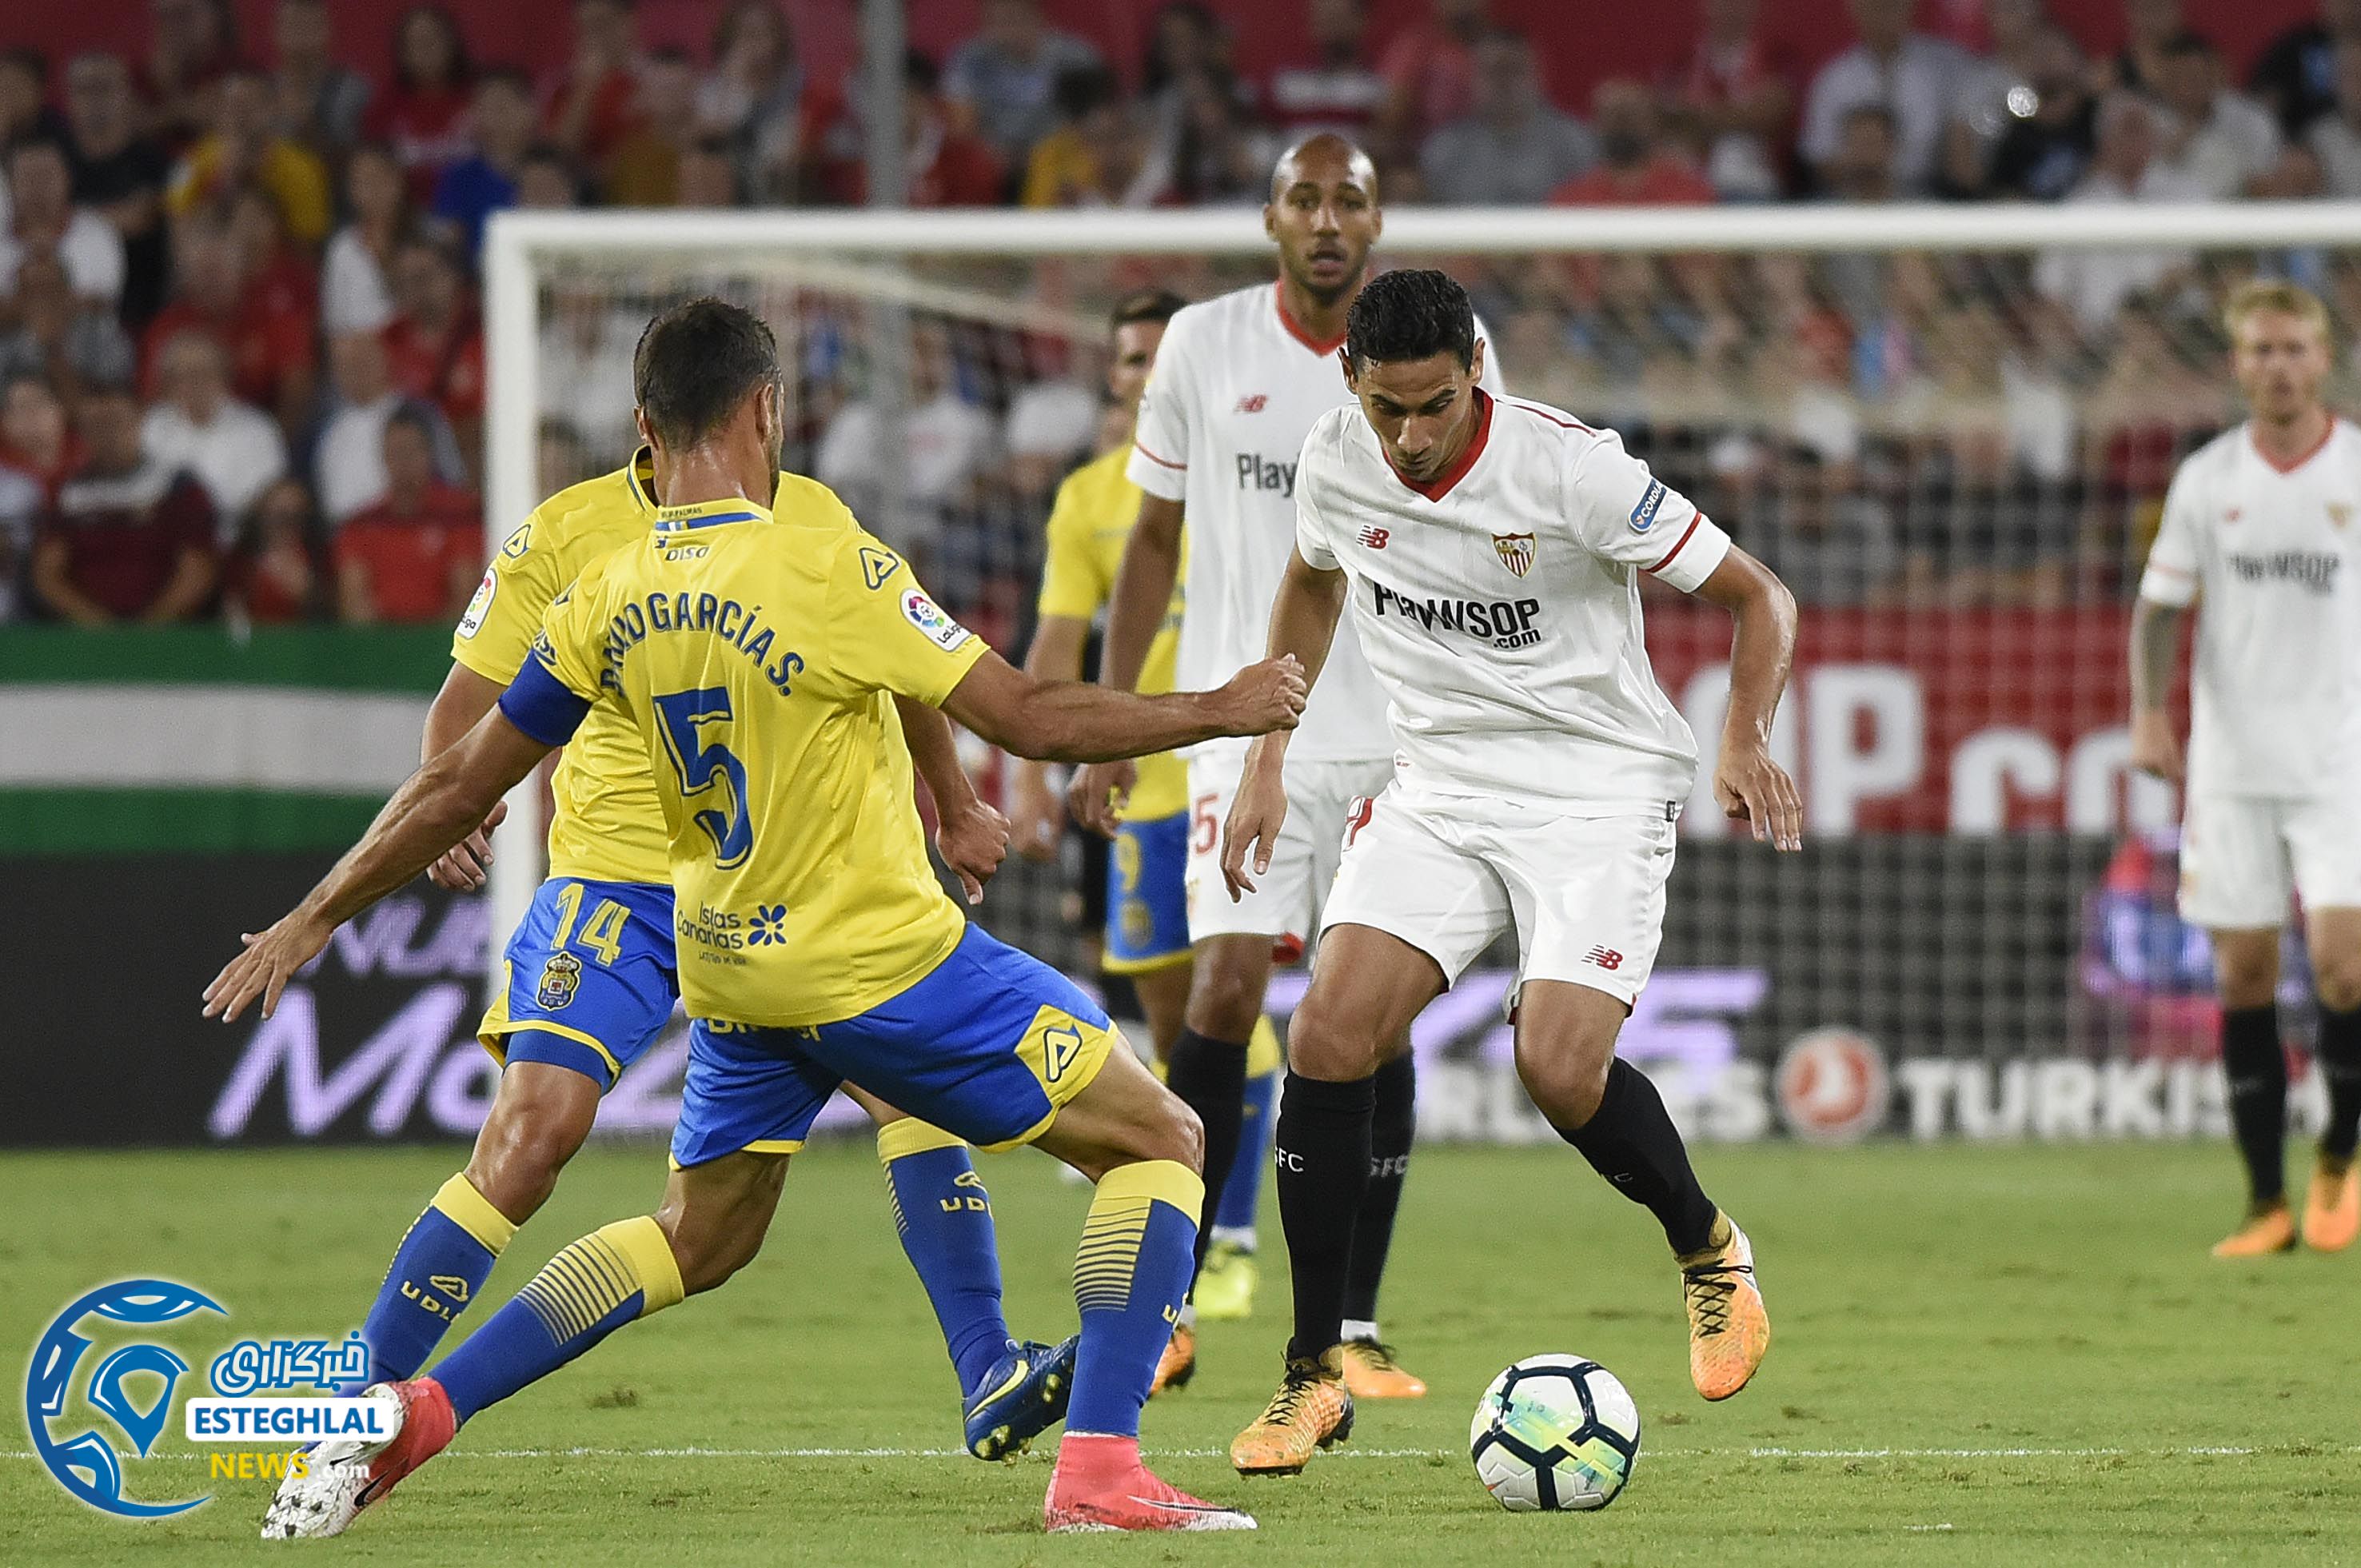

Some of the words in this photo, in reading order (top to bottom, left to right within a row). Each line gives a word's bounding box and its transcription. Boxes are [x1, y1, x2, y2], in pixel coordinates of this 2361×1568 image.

[1236, 453, 1300, 498] Play
[646, 592, 777, 668] GARCÍA
[1493, 628, 1541, 649] .com
[652, 685, 753, 871] 5
[551, 882, 632, 968] 14
[676, 909, 744, 950] Canarias
[699, 900, 742, 929] Islas
[401, 1280, 462, 1323] UDL
